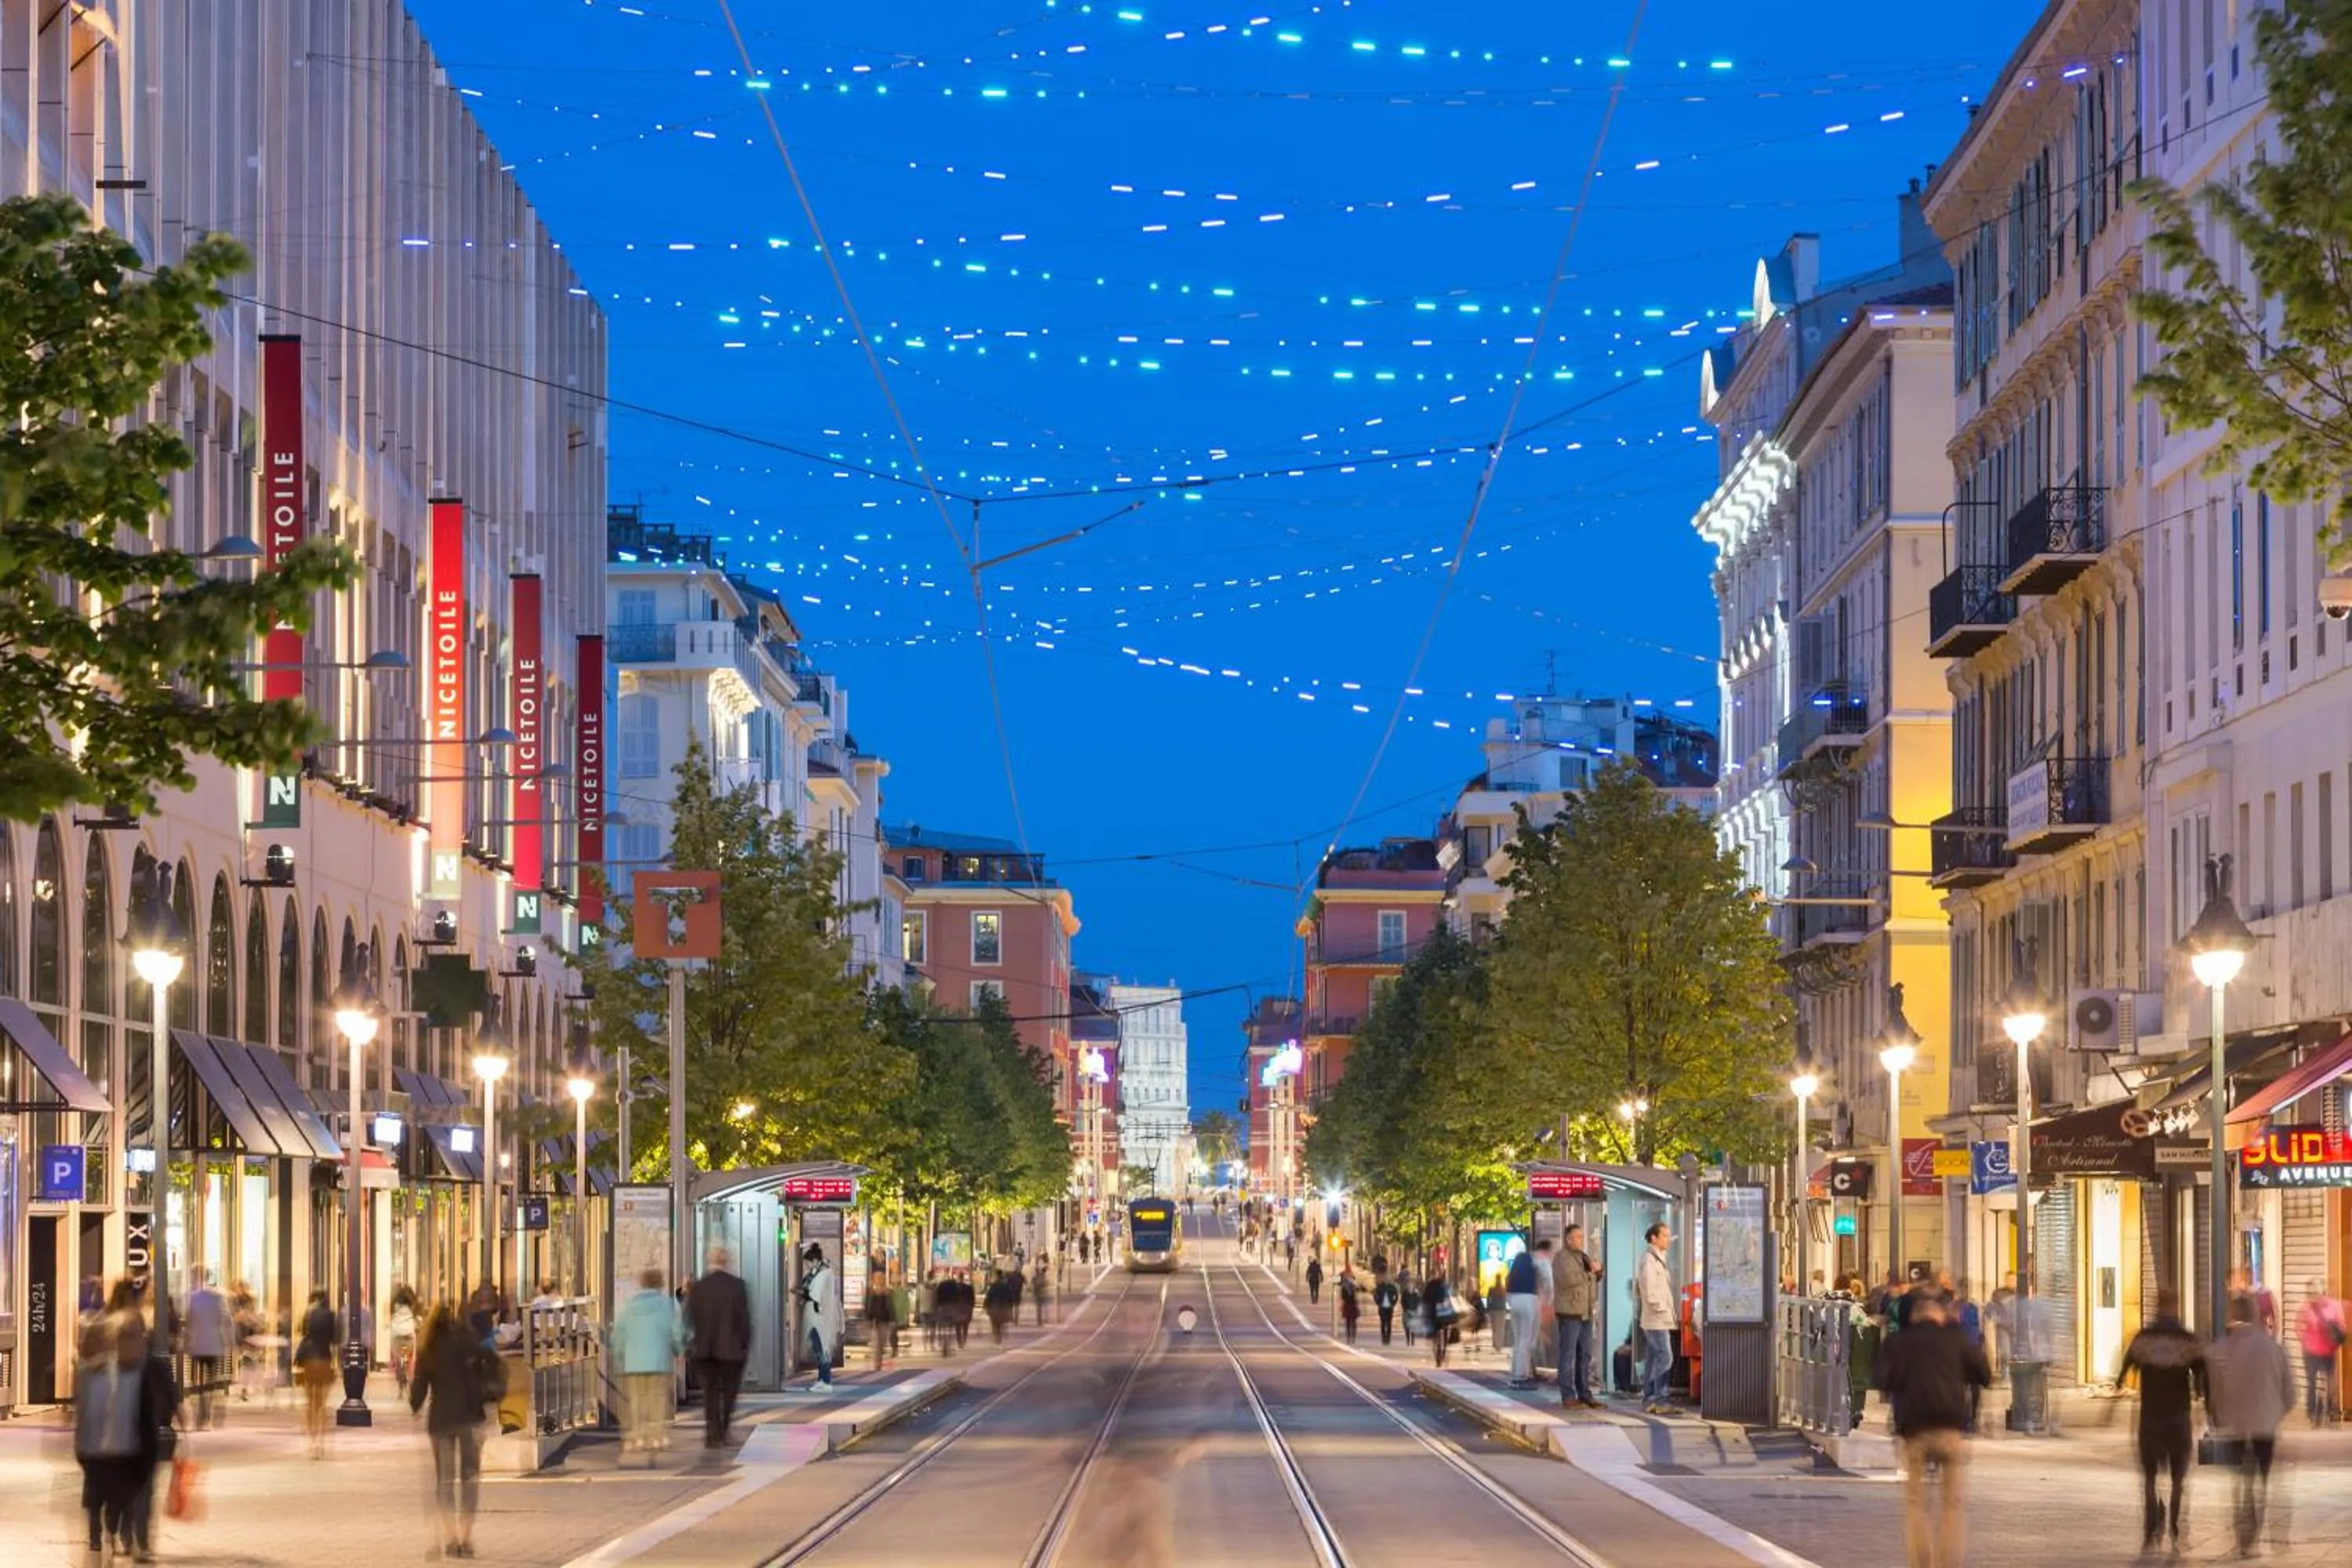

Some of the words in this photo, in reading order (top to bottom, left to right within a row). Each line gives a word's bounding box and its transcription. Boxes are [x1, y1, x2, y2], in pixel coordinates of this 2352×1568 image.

[438, 591, 457, 739] NICETOILE
[520, 659, 536, 791] NICETOILE
[583, 713, 598, 832] NICETOILE
[270, 775, 296, 804] N
[517, 896, 537, 918] N
[54, 1162, 71, 1185] P
[1834, 1173, 1851, 1190] C
[531, 1207, 541, 1222] P
[32, 1282, 45, 1333] 24h/24
